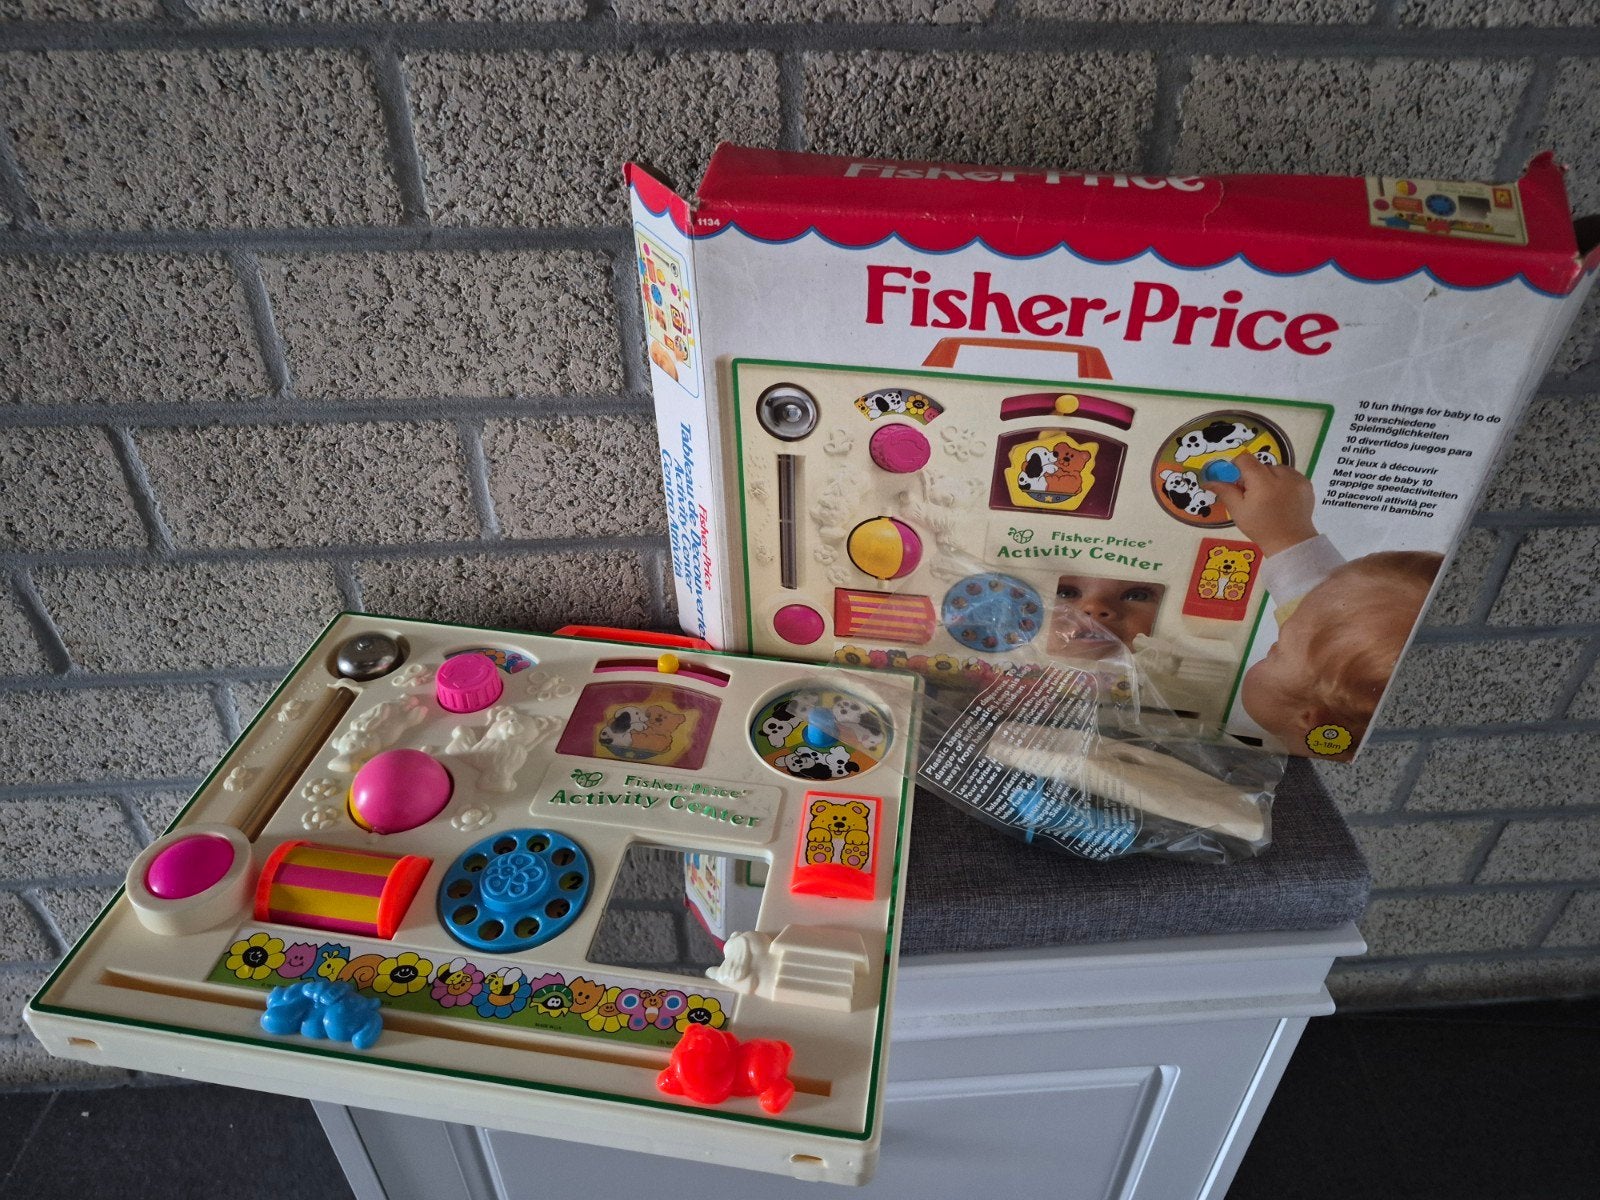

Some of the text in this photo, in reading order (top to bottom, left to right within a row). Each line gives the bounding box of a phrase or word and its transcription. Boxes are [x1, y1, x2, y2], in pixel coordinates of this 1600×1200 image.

[697, 217, 720, 227] 1134
[865, 264, 1340, 356] Fisher-Price
[1359, 401, 1501, 423] 10 fun things for baby to do
[1366, 415, 1436, 429] verschiedene
[1350, 423, 1450, 440] Spielmöglichkeiten
[1354, 446, 1376, 455] niño
[1358, 437, 1409, 449] divertidos
[1410, 443, 1446, 454] juegos
[1448, 449, 1473, 457] para
[680, 421, 695, 499] Tableau
[1337, 457, 1439, 475] Dix jeux à découvrir
[661, 448, 676, 515] Centro
[1333, 469, 1352, 477] Met
[1354, 472, 1377, 480] voor
[1379, 474, 1392, 482] de
[1394, 475, 1420, 486] baby
[1329, 480, 1458, 500] grappige speelactiviteiten
[1338, 491, 1384, 502] piacevoli
[1419, 501, 1437, 509] per
[687, 499, 699, 527] de
[1322, 498, 1434, 518] intrattenere il bambino
[673, 458, 693, 594] Activity Center
[997, 545, 1163, 571] Activity Center
[925, 744, 949, 775] Plastic
[945, 726, 964, 748] bags
[961, 715, 973, 729] can
[970, 704, 982, 716] be
[933, 751, 958, 781] danger
[954, 740, 965, 752] of
[941, 762, 962, 786] away
[956, 742, 976, 764] from
[972, 719, 993, 744] babies
[956, 757, 986, 795] Les sacs de
[962, 782, 978, 800] Pour
[974, 761, 993, 784] éviter
[979, 783, 988, 793] ce
[986, 771, 998, 785] sac
[549, 790, 760, 827] Activity Center
